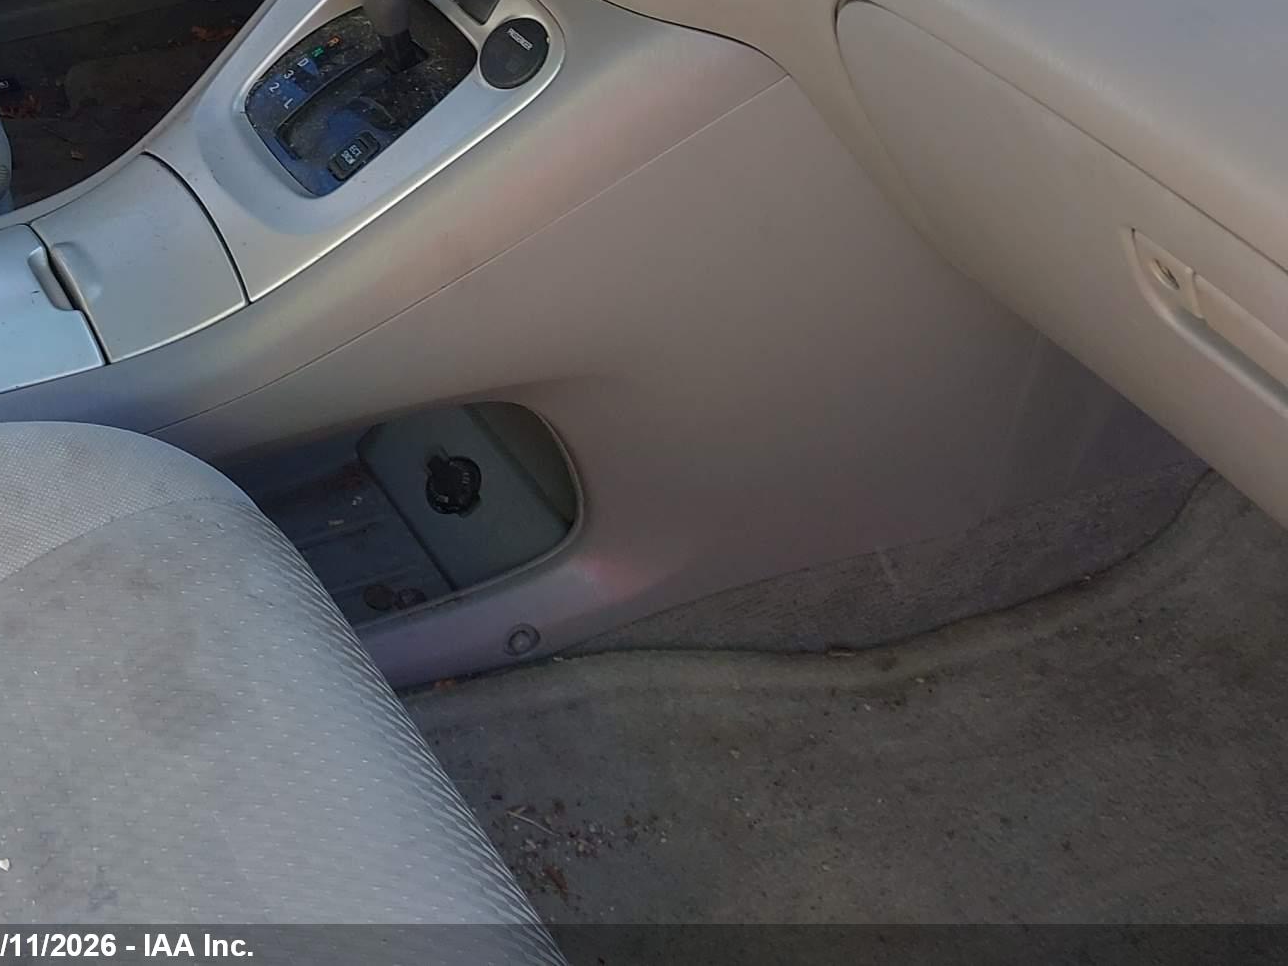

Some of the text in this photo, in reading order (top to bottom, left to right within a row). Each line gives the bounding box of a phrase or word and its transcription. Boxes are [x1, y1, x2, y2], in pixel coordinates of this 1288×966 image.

[297, 57, 309, 67] D
[283, 69, 295, 79] 3
[269, 82, 280, 93] 2
[283, 97, 294, 110] L
